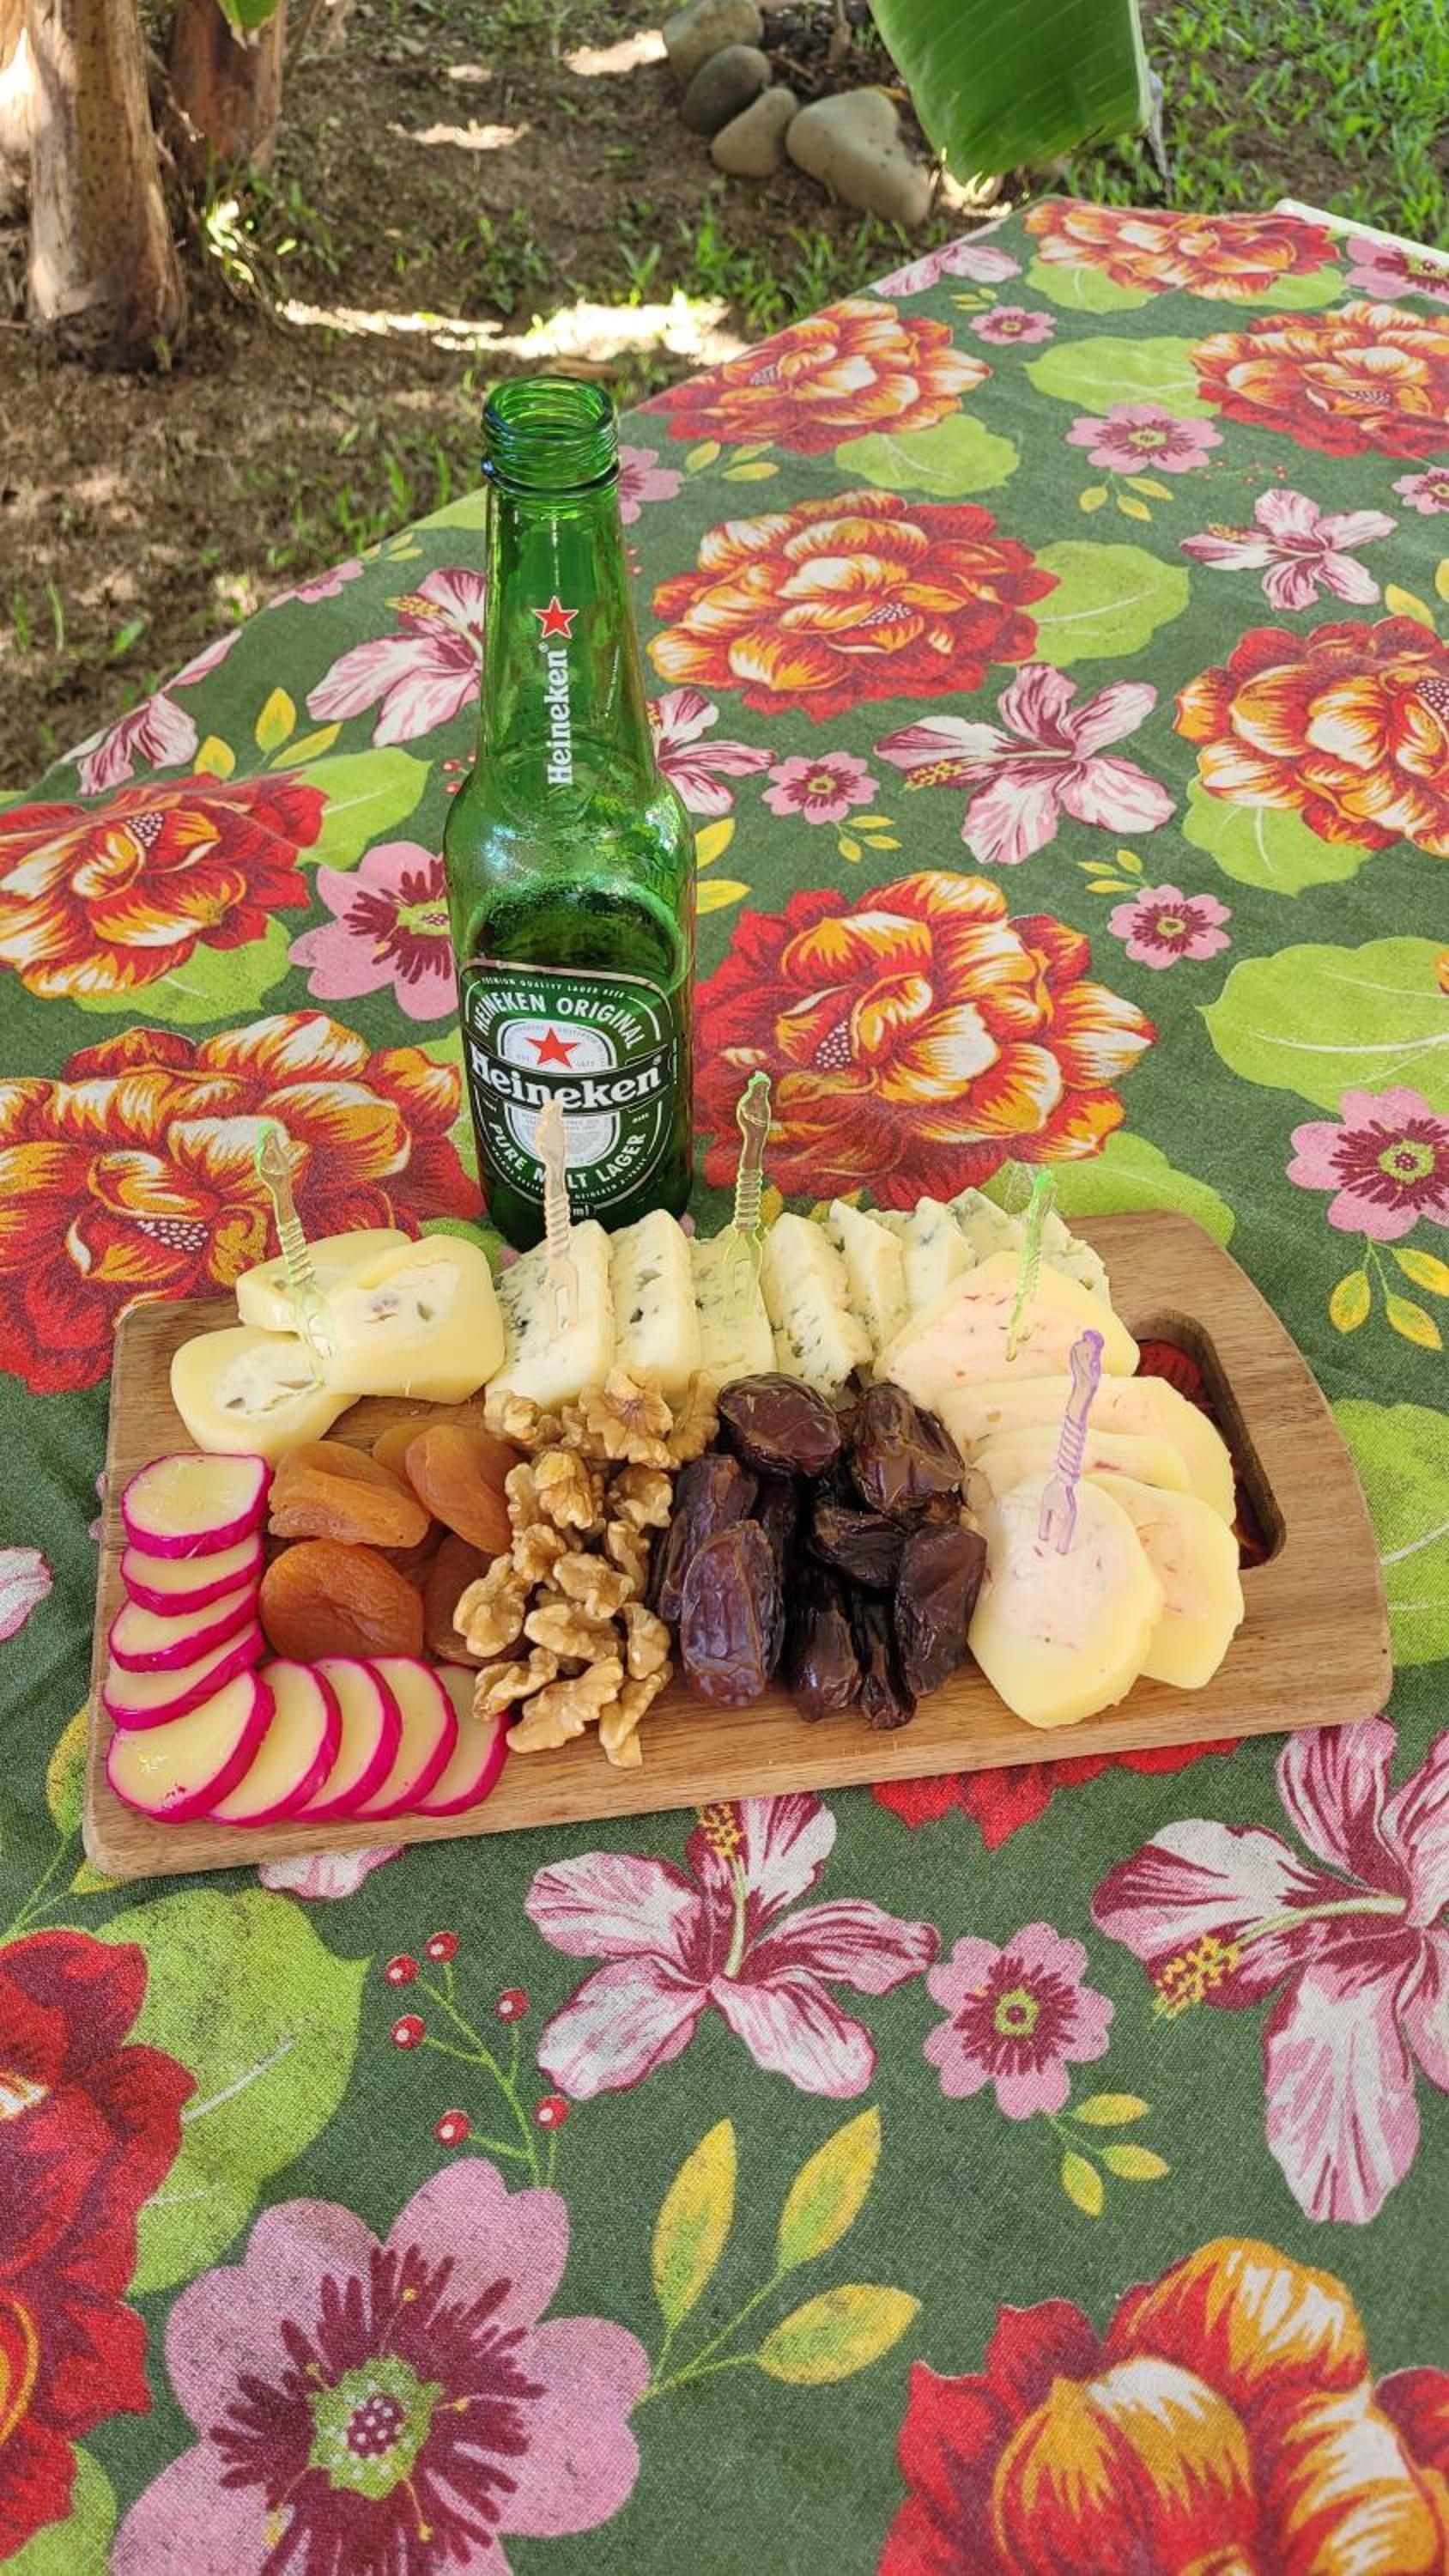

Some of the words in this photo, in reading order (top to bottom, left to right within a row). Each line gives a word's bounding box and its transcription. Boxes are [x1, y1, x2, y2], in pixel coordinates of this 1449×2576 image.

[543, 648, 573, 785] Heineken
[474, 991, 547, 1036] HEINEKEN
[556, 997, 646, 1050] ORIGINAL
[470, 1040, 661, 1109] Heineken
[488, 1121, 528, 1170] PURE
[533, 1167, 588, 1189] MLT
[595, 1133, 646, 1182] LAGER
